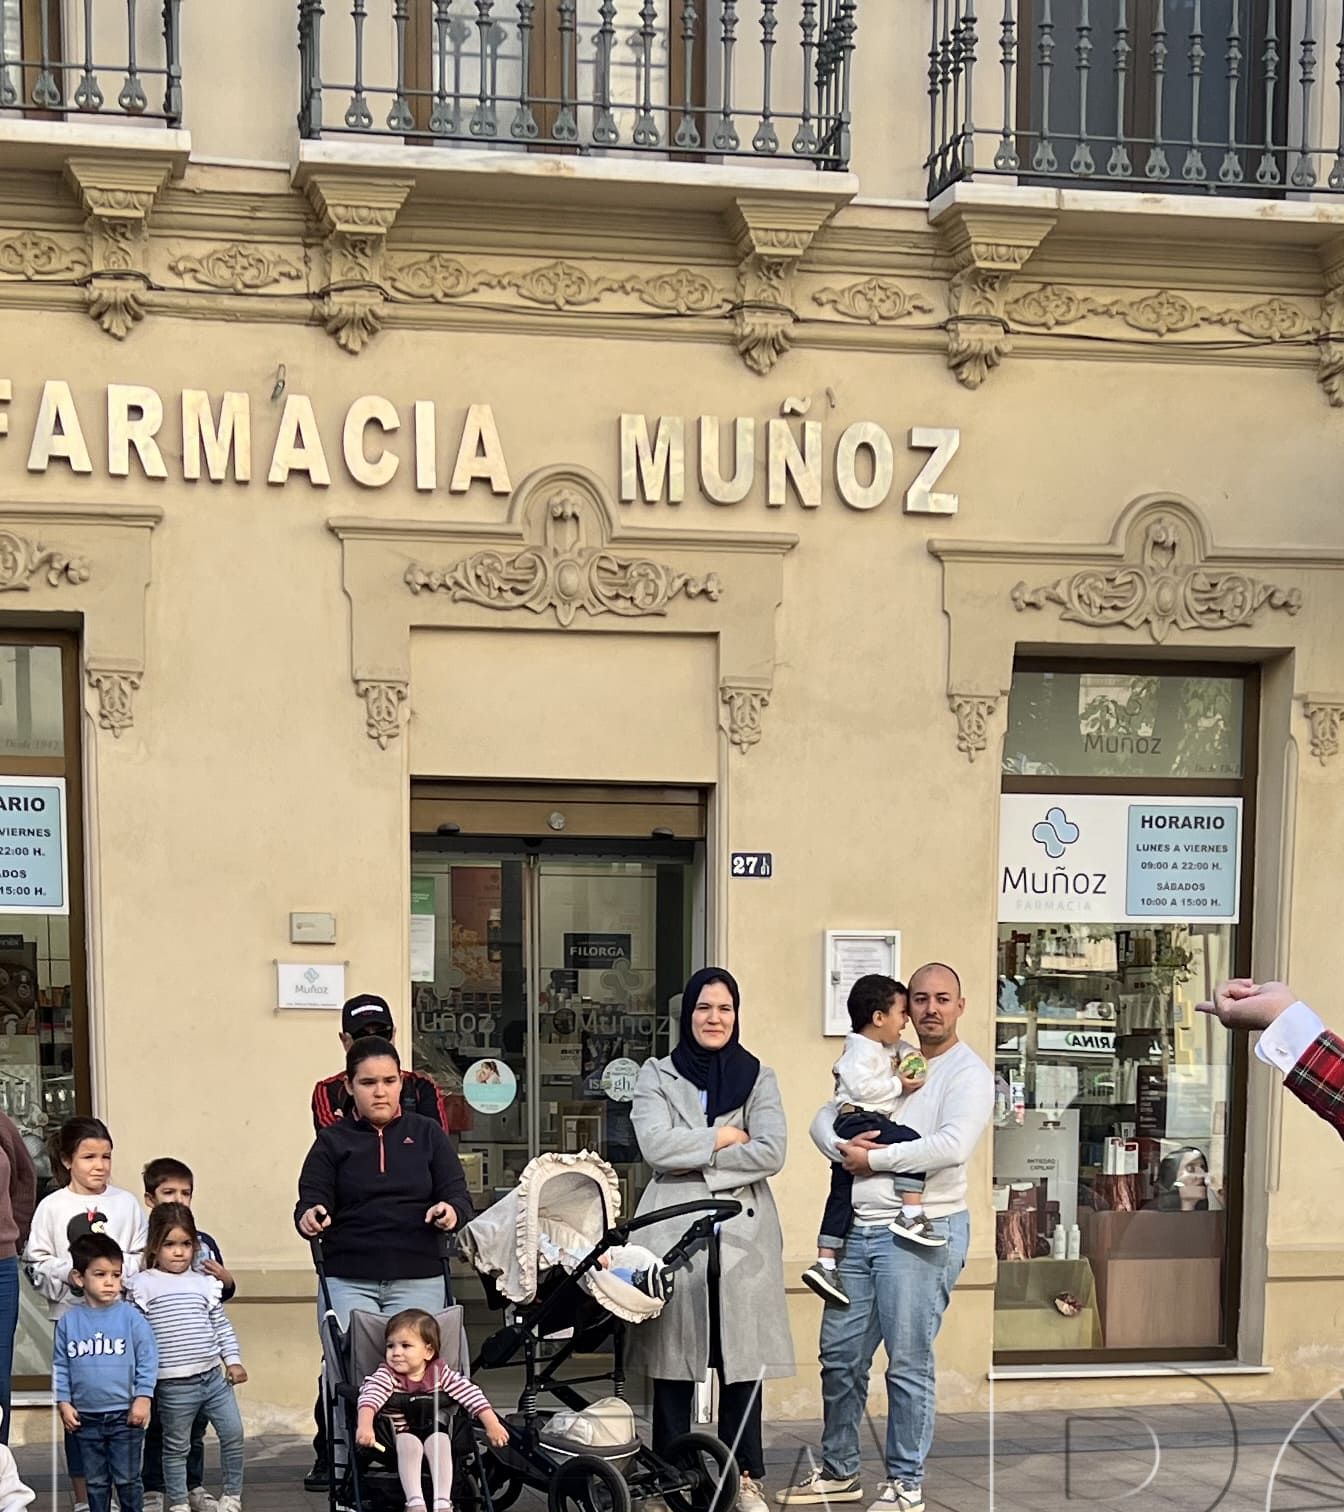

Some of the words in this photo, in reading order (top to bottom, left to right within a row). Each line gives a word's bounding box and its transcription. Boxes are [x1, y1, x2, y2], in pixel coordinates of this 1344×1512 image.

[619, 397, 960, 515] MUÑOZ
[1140, 815, 1225, 830] HORARIO
[1136, 843, 1171, 853] LUNES
[1173, 844, 1181, 853] A
[1184, 844, 1229, 853] VIERNES
[733, 856, 758, 875] 27
[1141, 861, 1168, 870] 09:00
[1171, 862, 1178, 871] A
[1181, 862, 1209, 871] 22:00
[1002, 866, 1107, 895] Muñoz
[0, 886, 30, 896] 15:00
[1016, 900, 1092, 912] FARMACIA
[1141, 897, 1168, 906] 10:00
[1170, 898, 1178, 906] A
[1181, 898, 1208, 907] 15:00
[570, 946, 624, 958] FILORGA
[295, 984, 329, 995] Muñoz
[67, 1333, 126, 1358] SMILE
